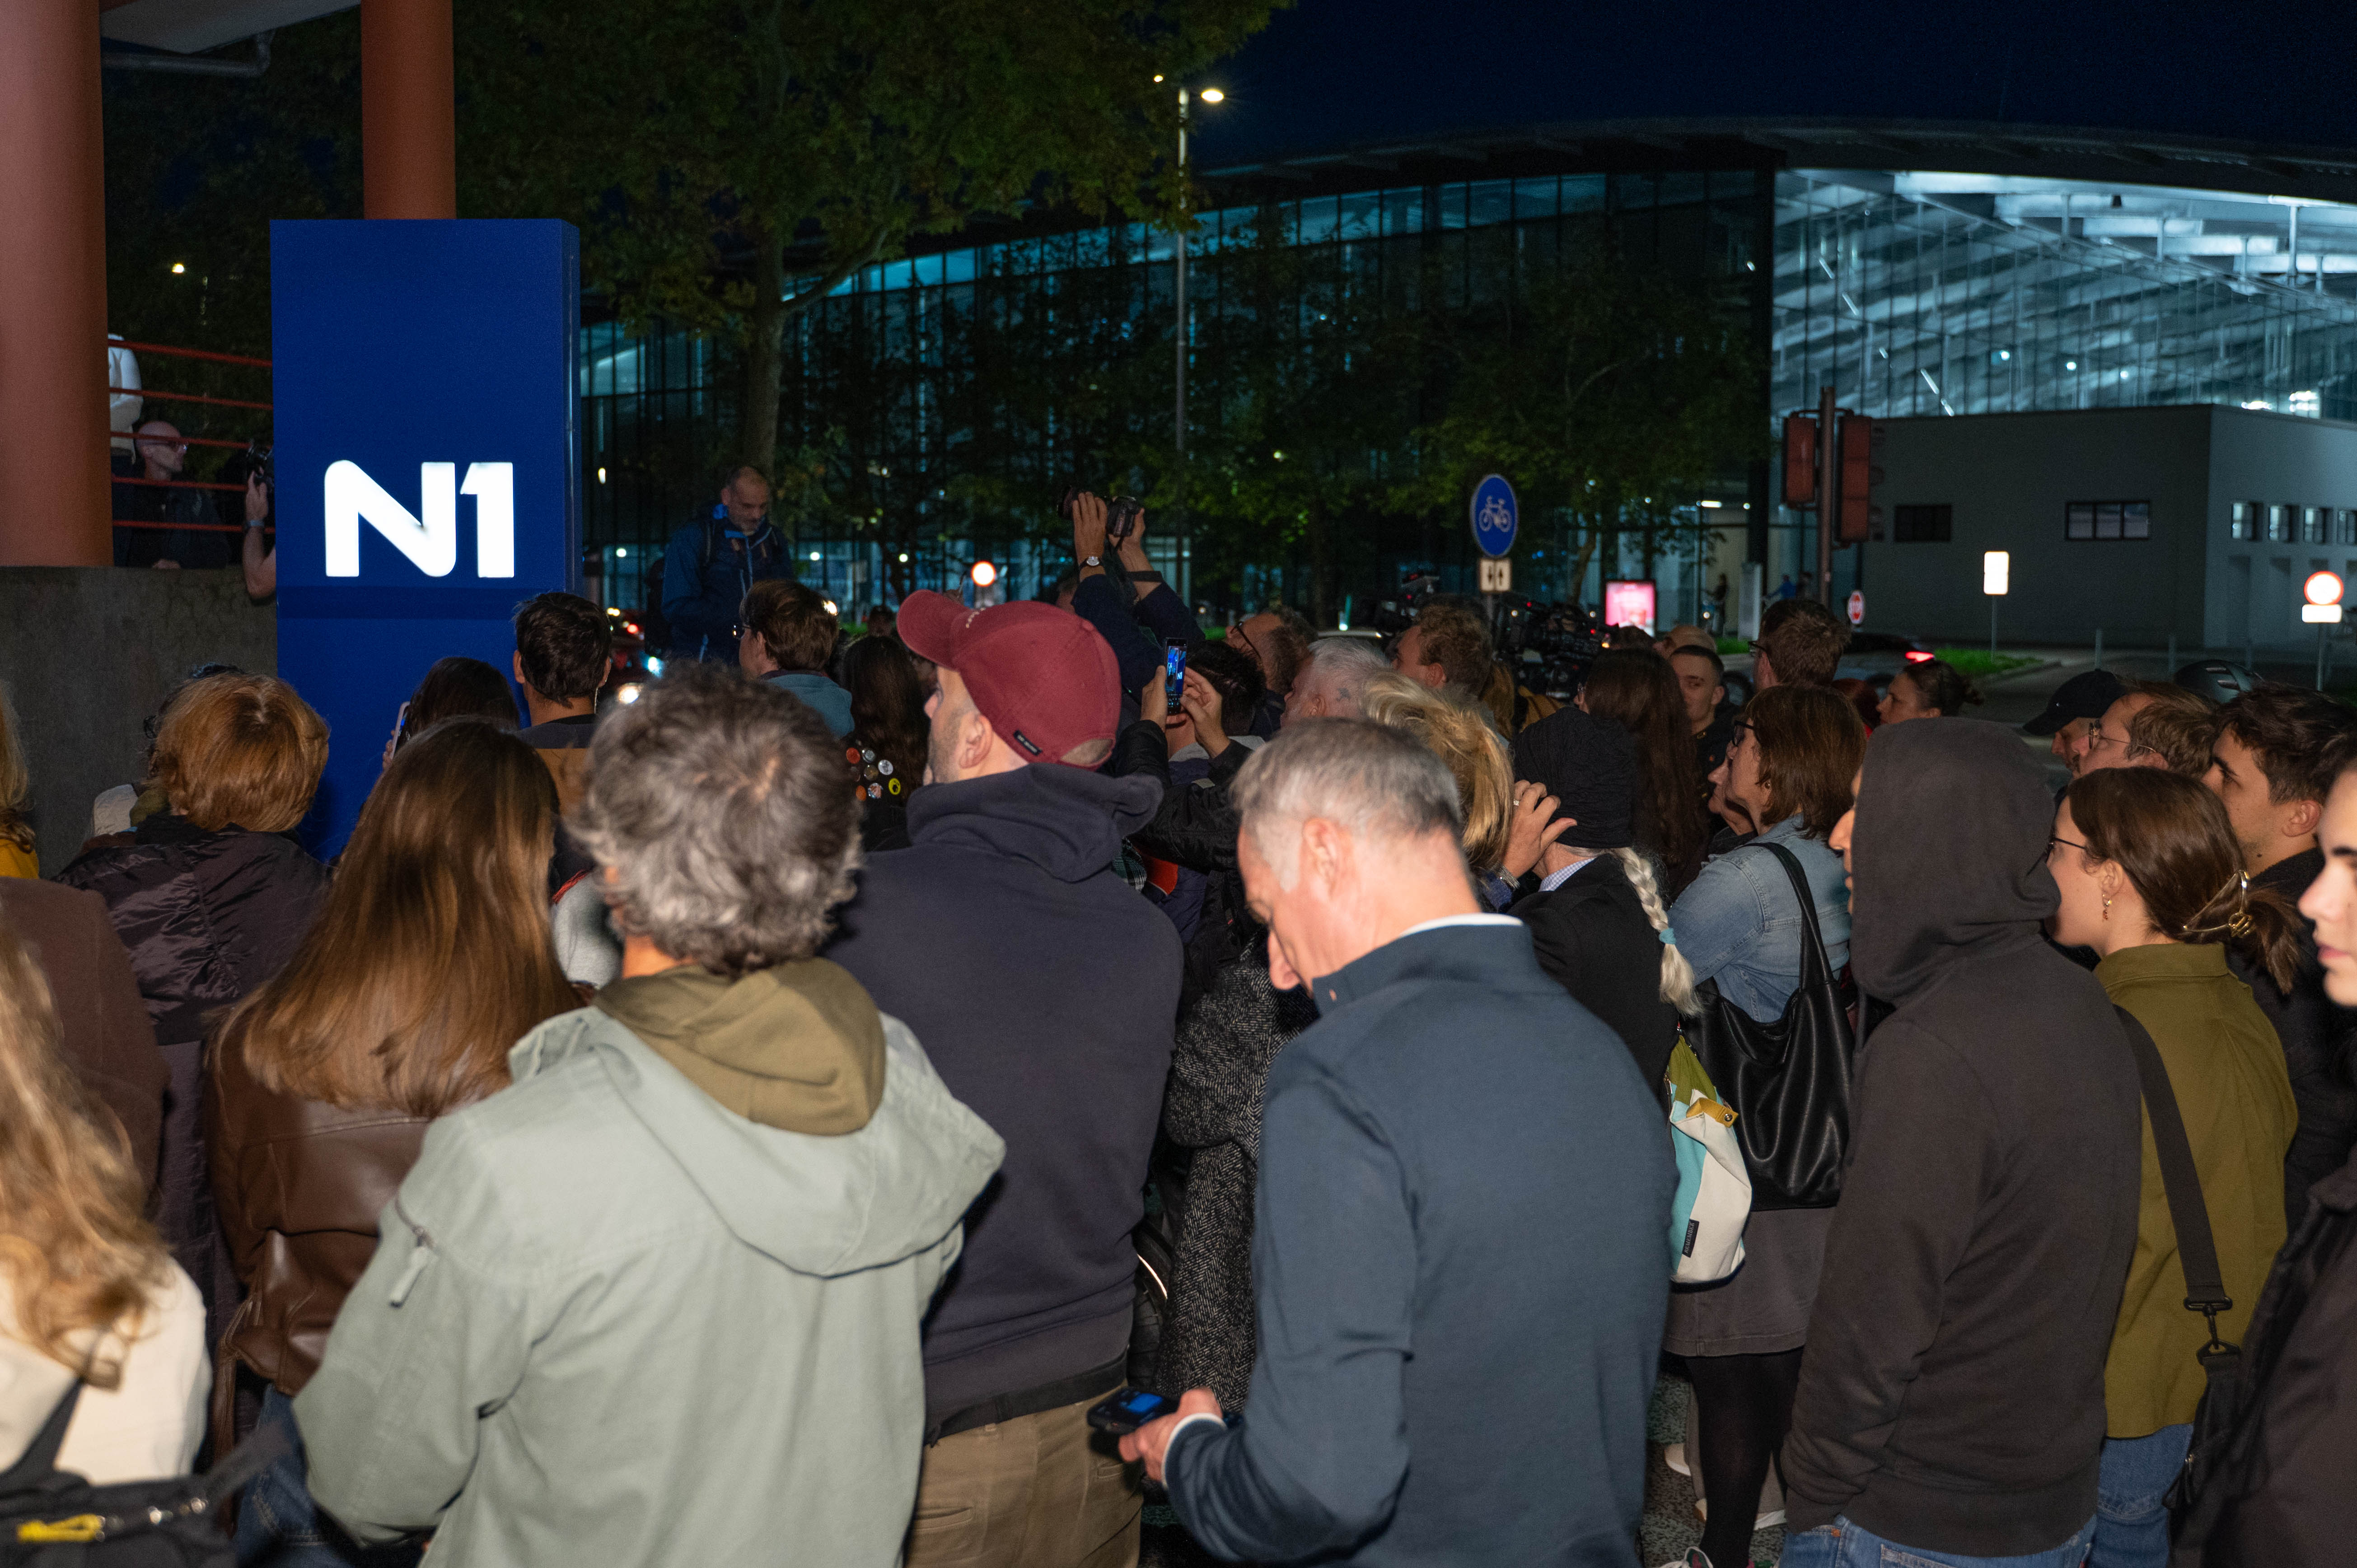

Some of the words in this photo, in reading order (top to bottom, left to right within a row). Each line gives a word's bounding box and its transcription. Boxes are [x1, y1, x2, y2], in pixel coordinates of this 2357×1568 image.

[325, 460, 514, 578] N1
[1177, 672, 1183, 680] N1
[1684, 1221, 1695, 1253] REMEMBER
